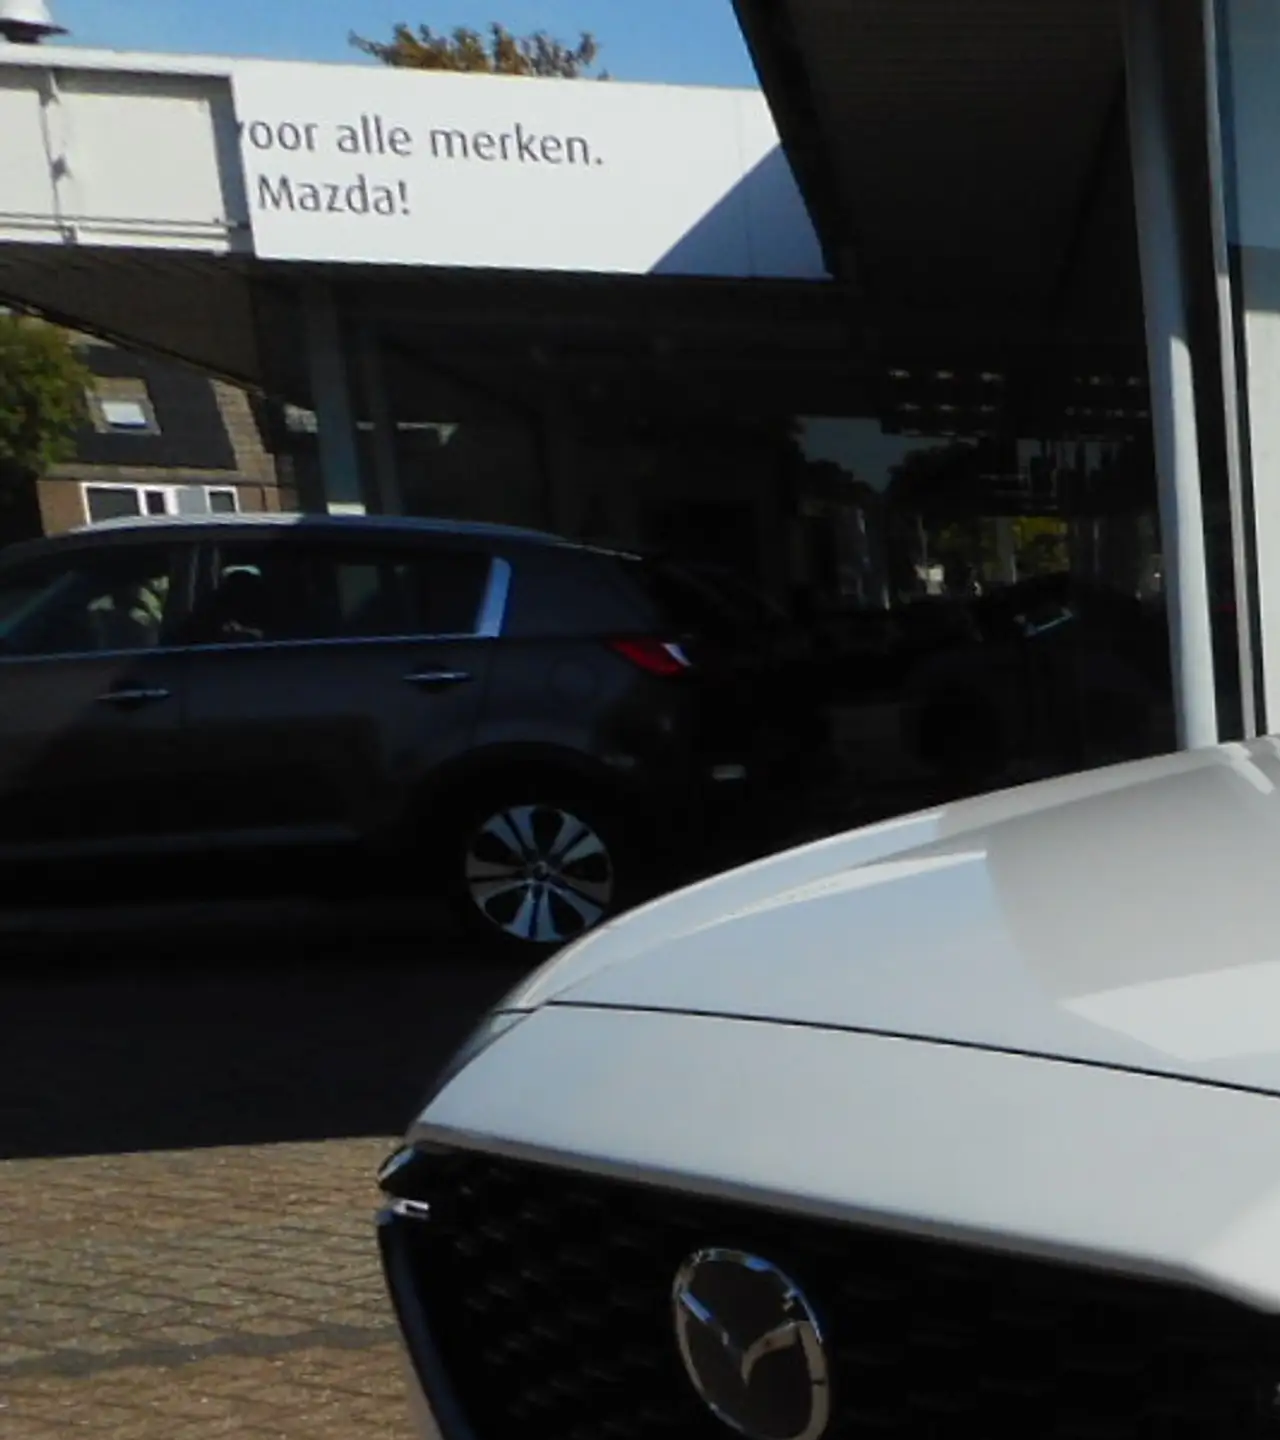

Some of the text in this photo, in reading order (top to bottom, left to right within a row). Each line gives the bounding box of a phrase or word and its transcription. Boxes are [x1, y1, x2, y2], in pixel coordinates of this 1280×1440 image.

[335, 113, 413, 157] alle
[428, 121, 604, 166] merken.
[256, 173, 411, 216] Mazda!
